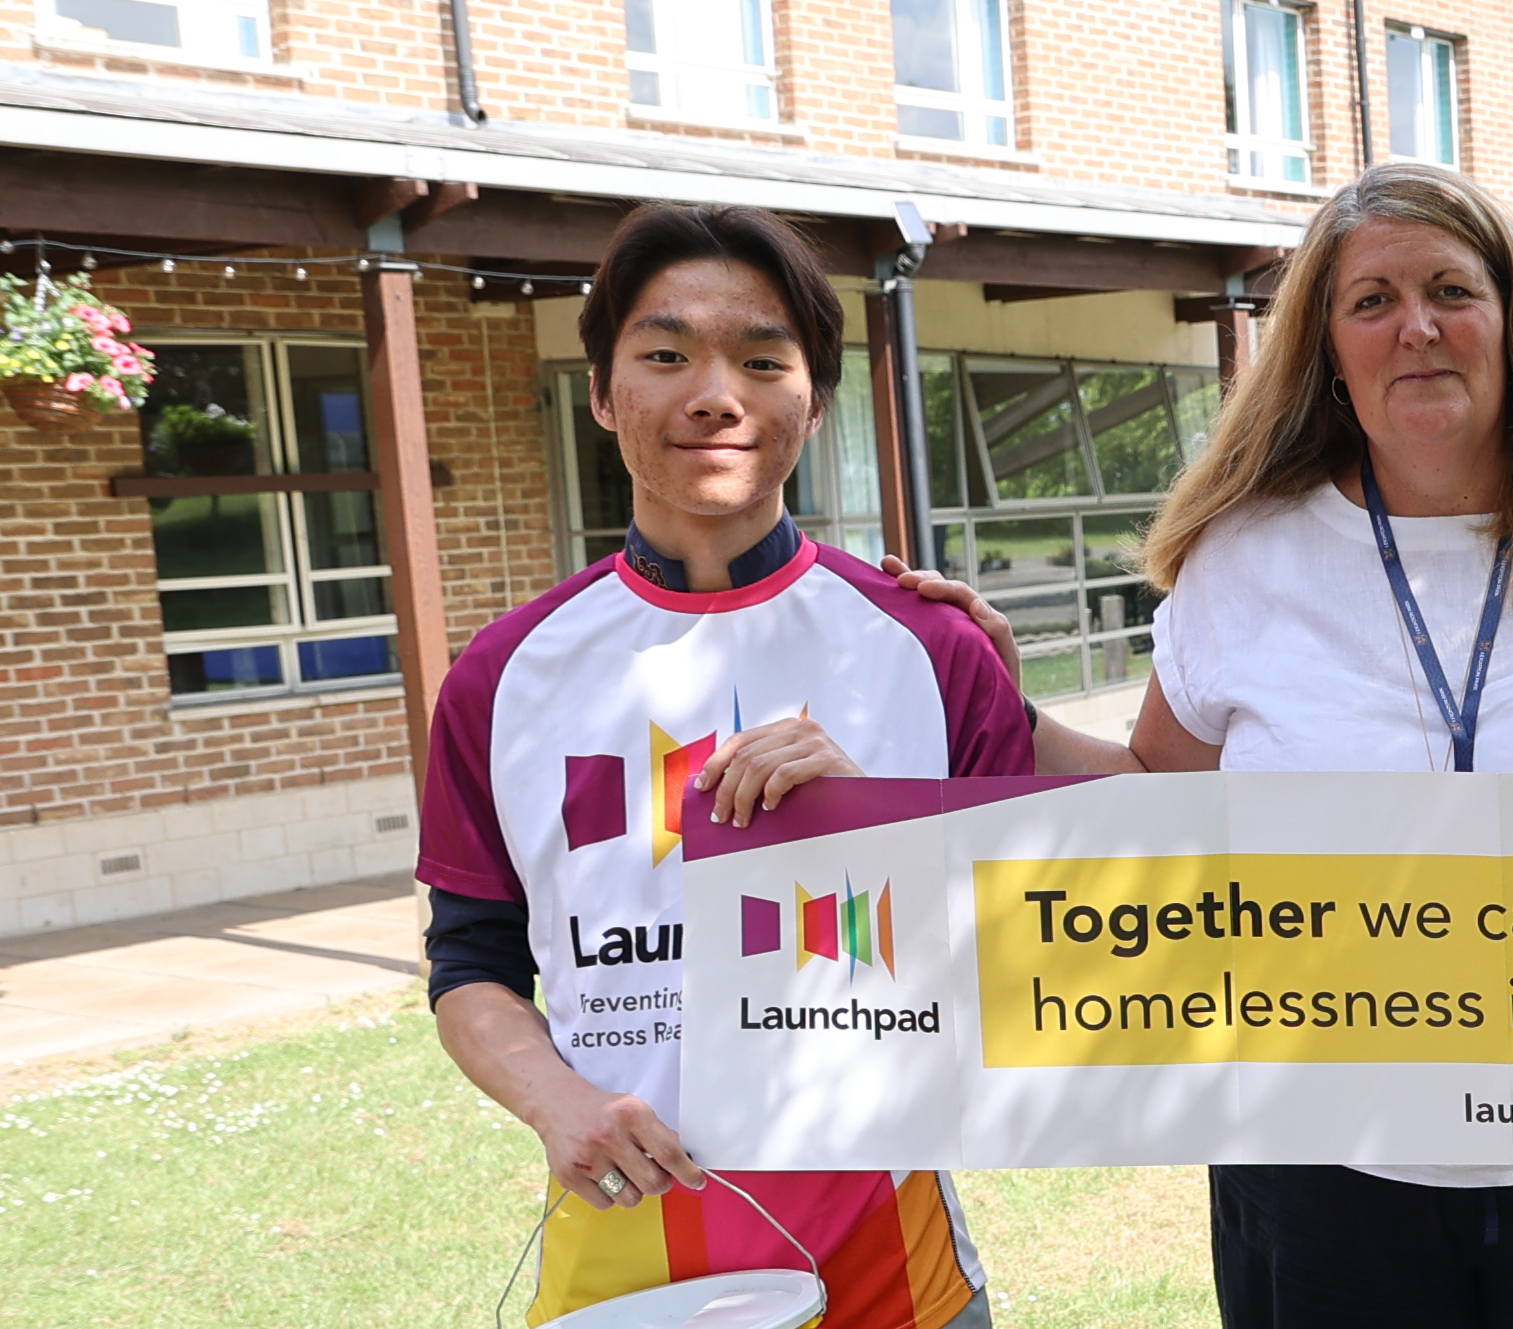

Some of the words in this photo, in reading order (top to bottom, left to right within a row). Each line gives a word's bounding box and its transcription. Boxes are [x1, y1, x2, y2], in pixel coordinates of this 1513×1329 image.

[1024, 881, 1337, 958] Together
[1358, 901, 1452, 939] we
[741, 996, 940, 1041] Launchpad
[1033, 971, 1486, 1031] homelessness
[571, 1029, 647, 1048] across
